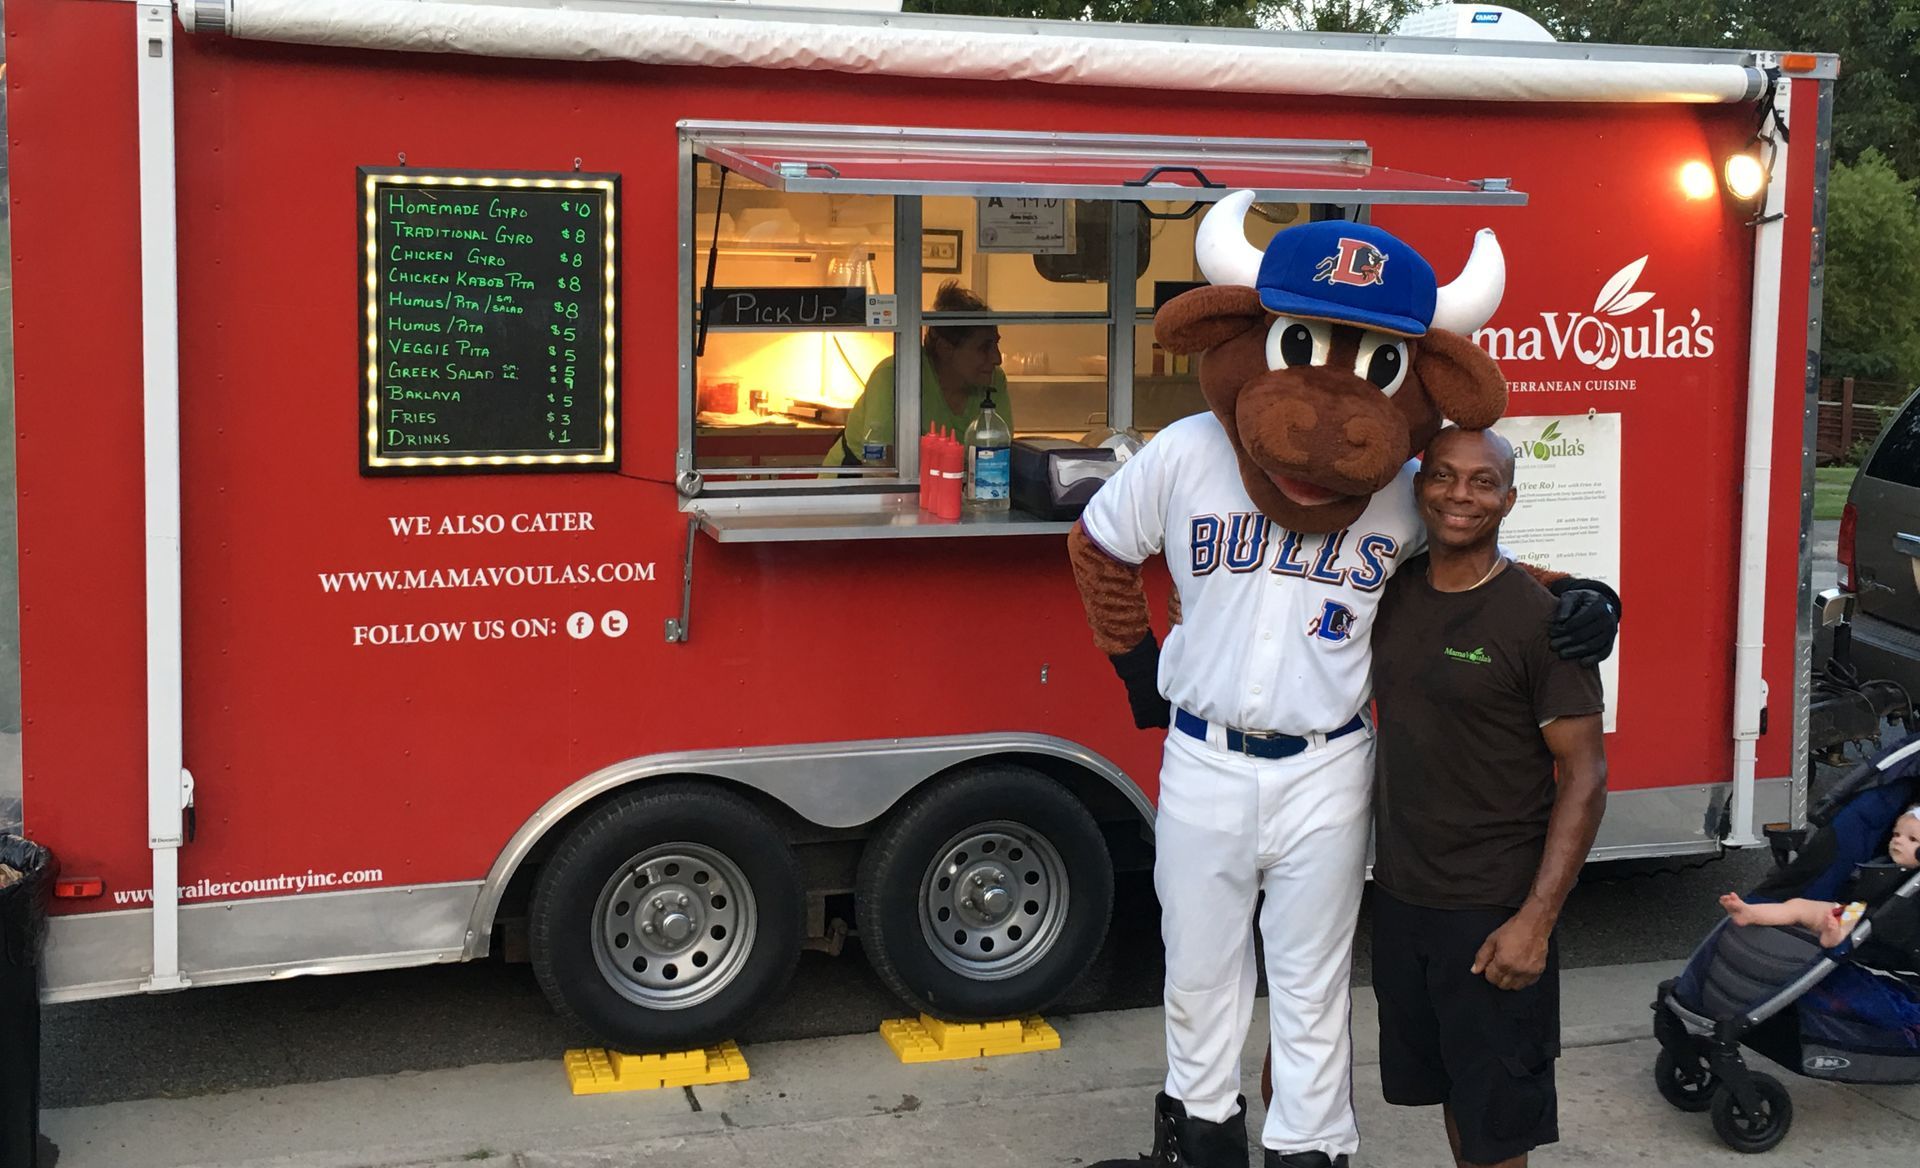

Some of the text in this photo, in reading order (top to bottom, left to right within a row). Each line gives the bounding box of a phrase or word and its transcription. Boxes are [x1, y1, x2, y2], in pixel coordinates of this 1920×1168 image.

[800, 294, 837, 322] UP
[1505, 379, 1637, 393] TERRANEAN CUISINE
[389, 511, 595, 536] WE ALSO CATER
[1189, 511, 1400, 593] BULLS
[1528, 551, 1550, 561] Gyro
[318, 562, 656, 593] WWW.MAMAVOULAS.COM
[353, 621, 466, 646] FOLLOW
[472, 619, 505, 640] US
[511, 617, 557, 638] ON:
